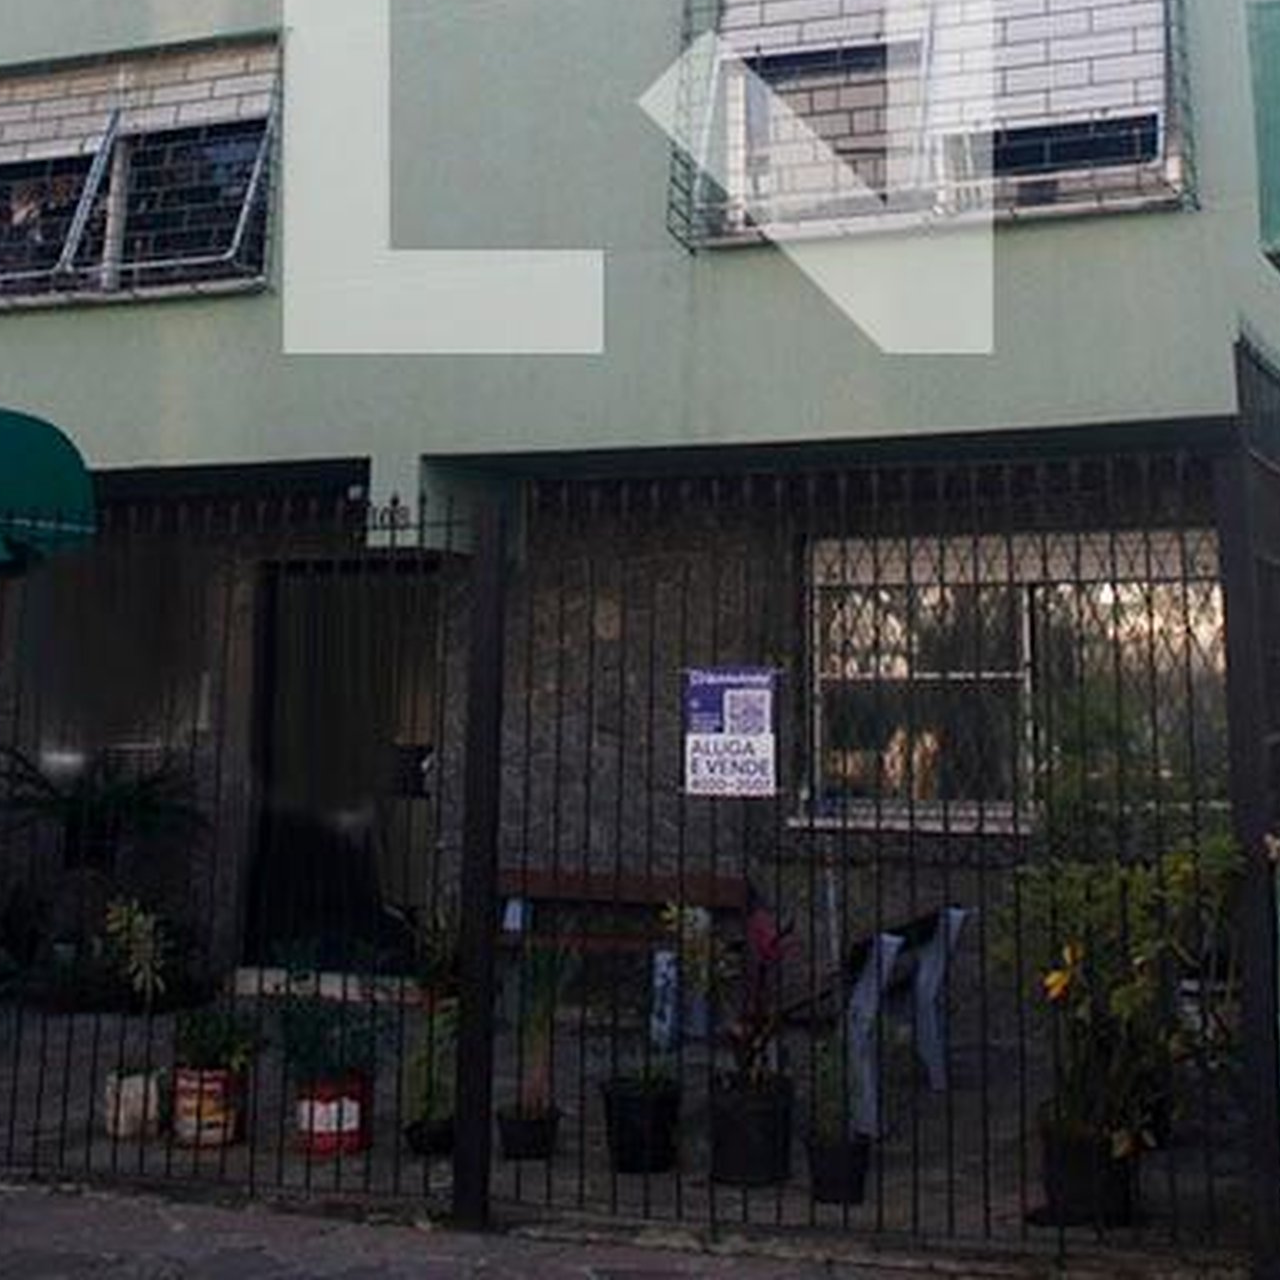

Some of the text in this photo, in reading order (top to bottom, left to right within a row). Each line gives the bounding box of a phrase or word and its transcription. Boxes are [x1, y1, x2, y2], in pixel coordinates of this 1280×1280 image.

[691, 739, 755, 757] ALUGA
[691, 759, 770, 776] E VENDE
